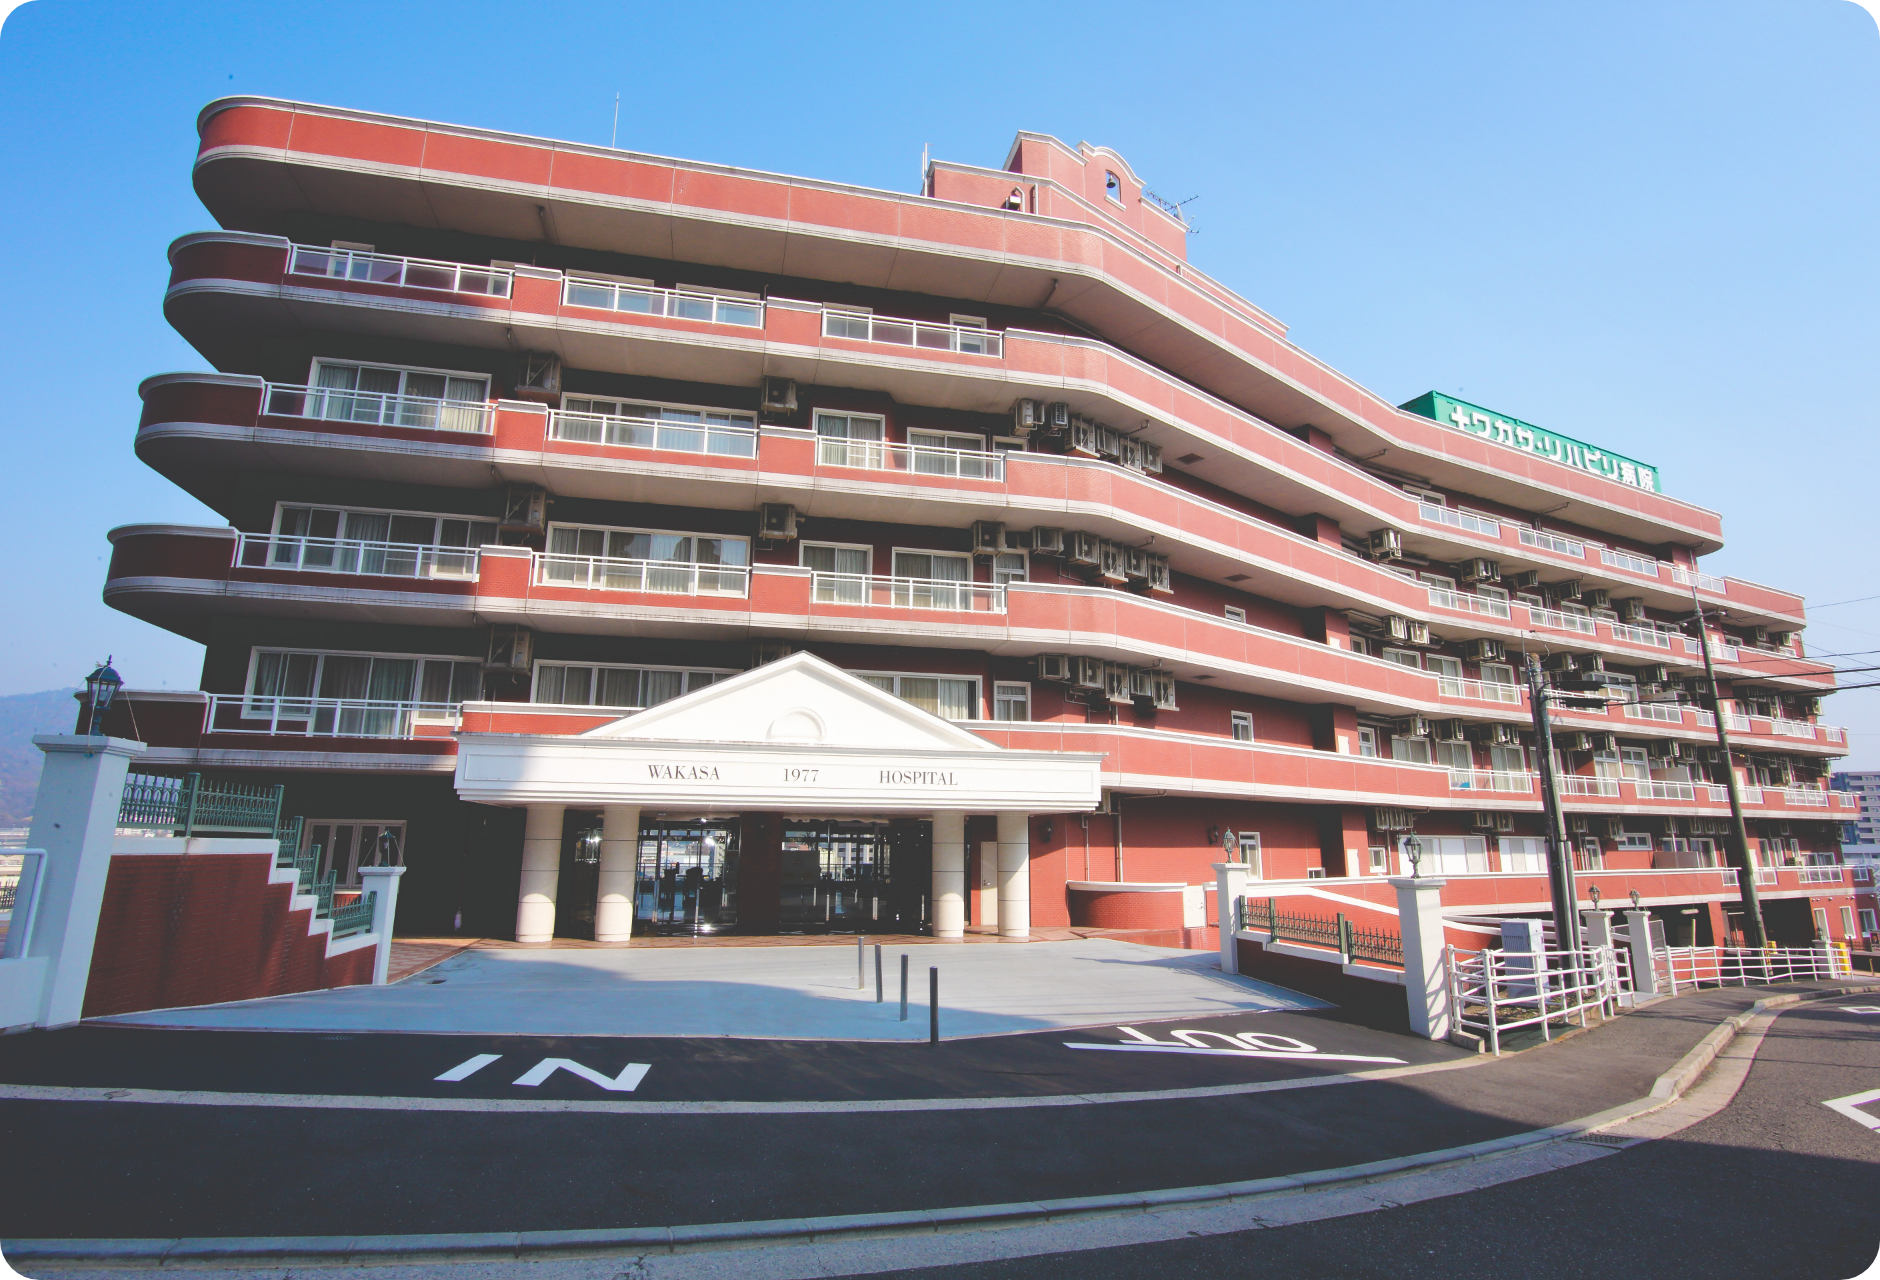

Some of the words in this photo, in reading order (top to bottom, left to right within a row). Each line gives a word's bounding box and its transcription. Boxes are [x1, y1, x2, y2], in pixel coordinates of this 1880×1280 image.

[647, 764, 720, 780] WAKASA
[784, 768, 819, 783] 1977
[879, 769, 958, 786] HOSPITAL
[1116, 1026, 1318, 1053] OUT
[433, 1053, 652, 1091] IN
